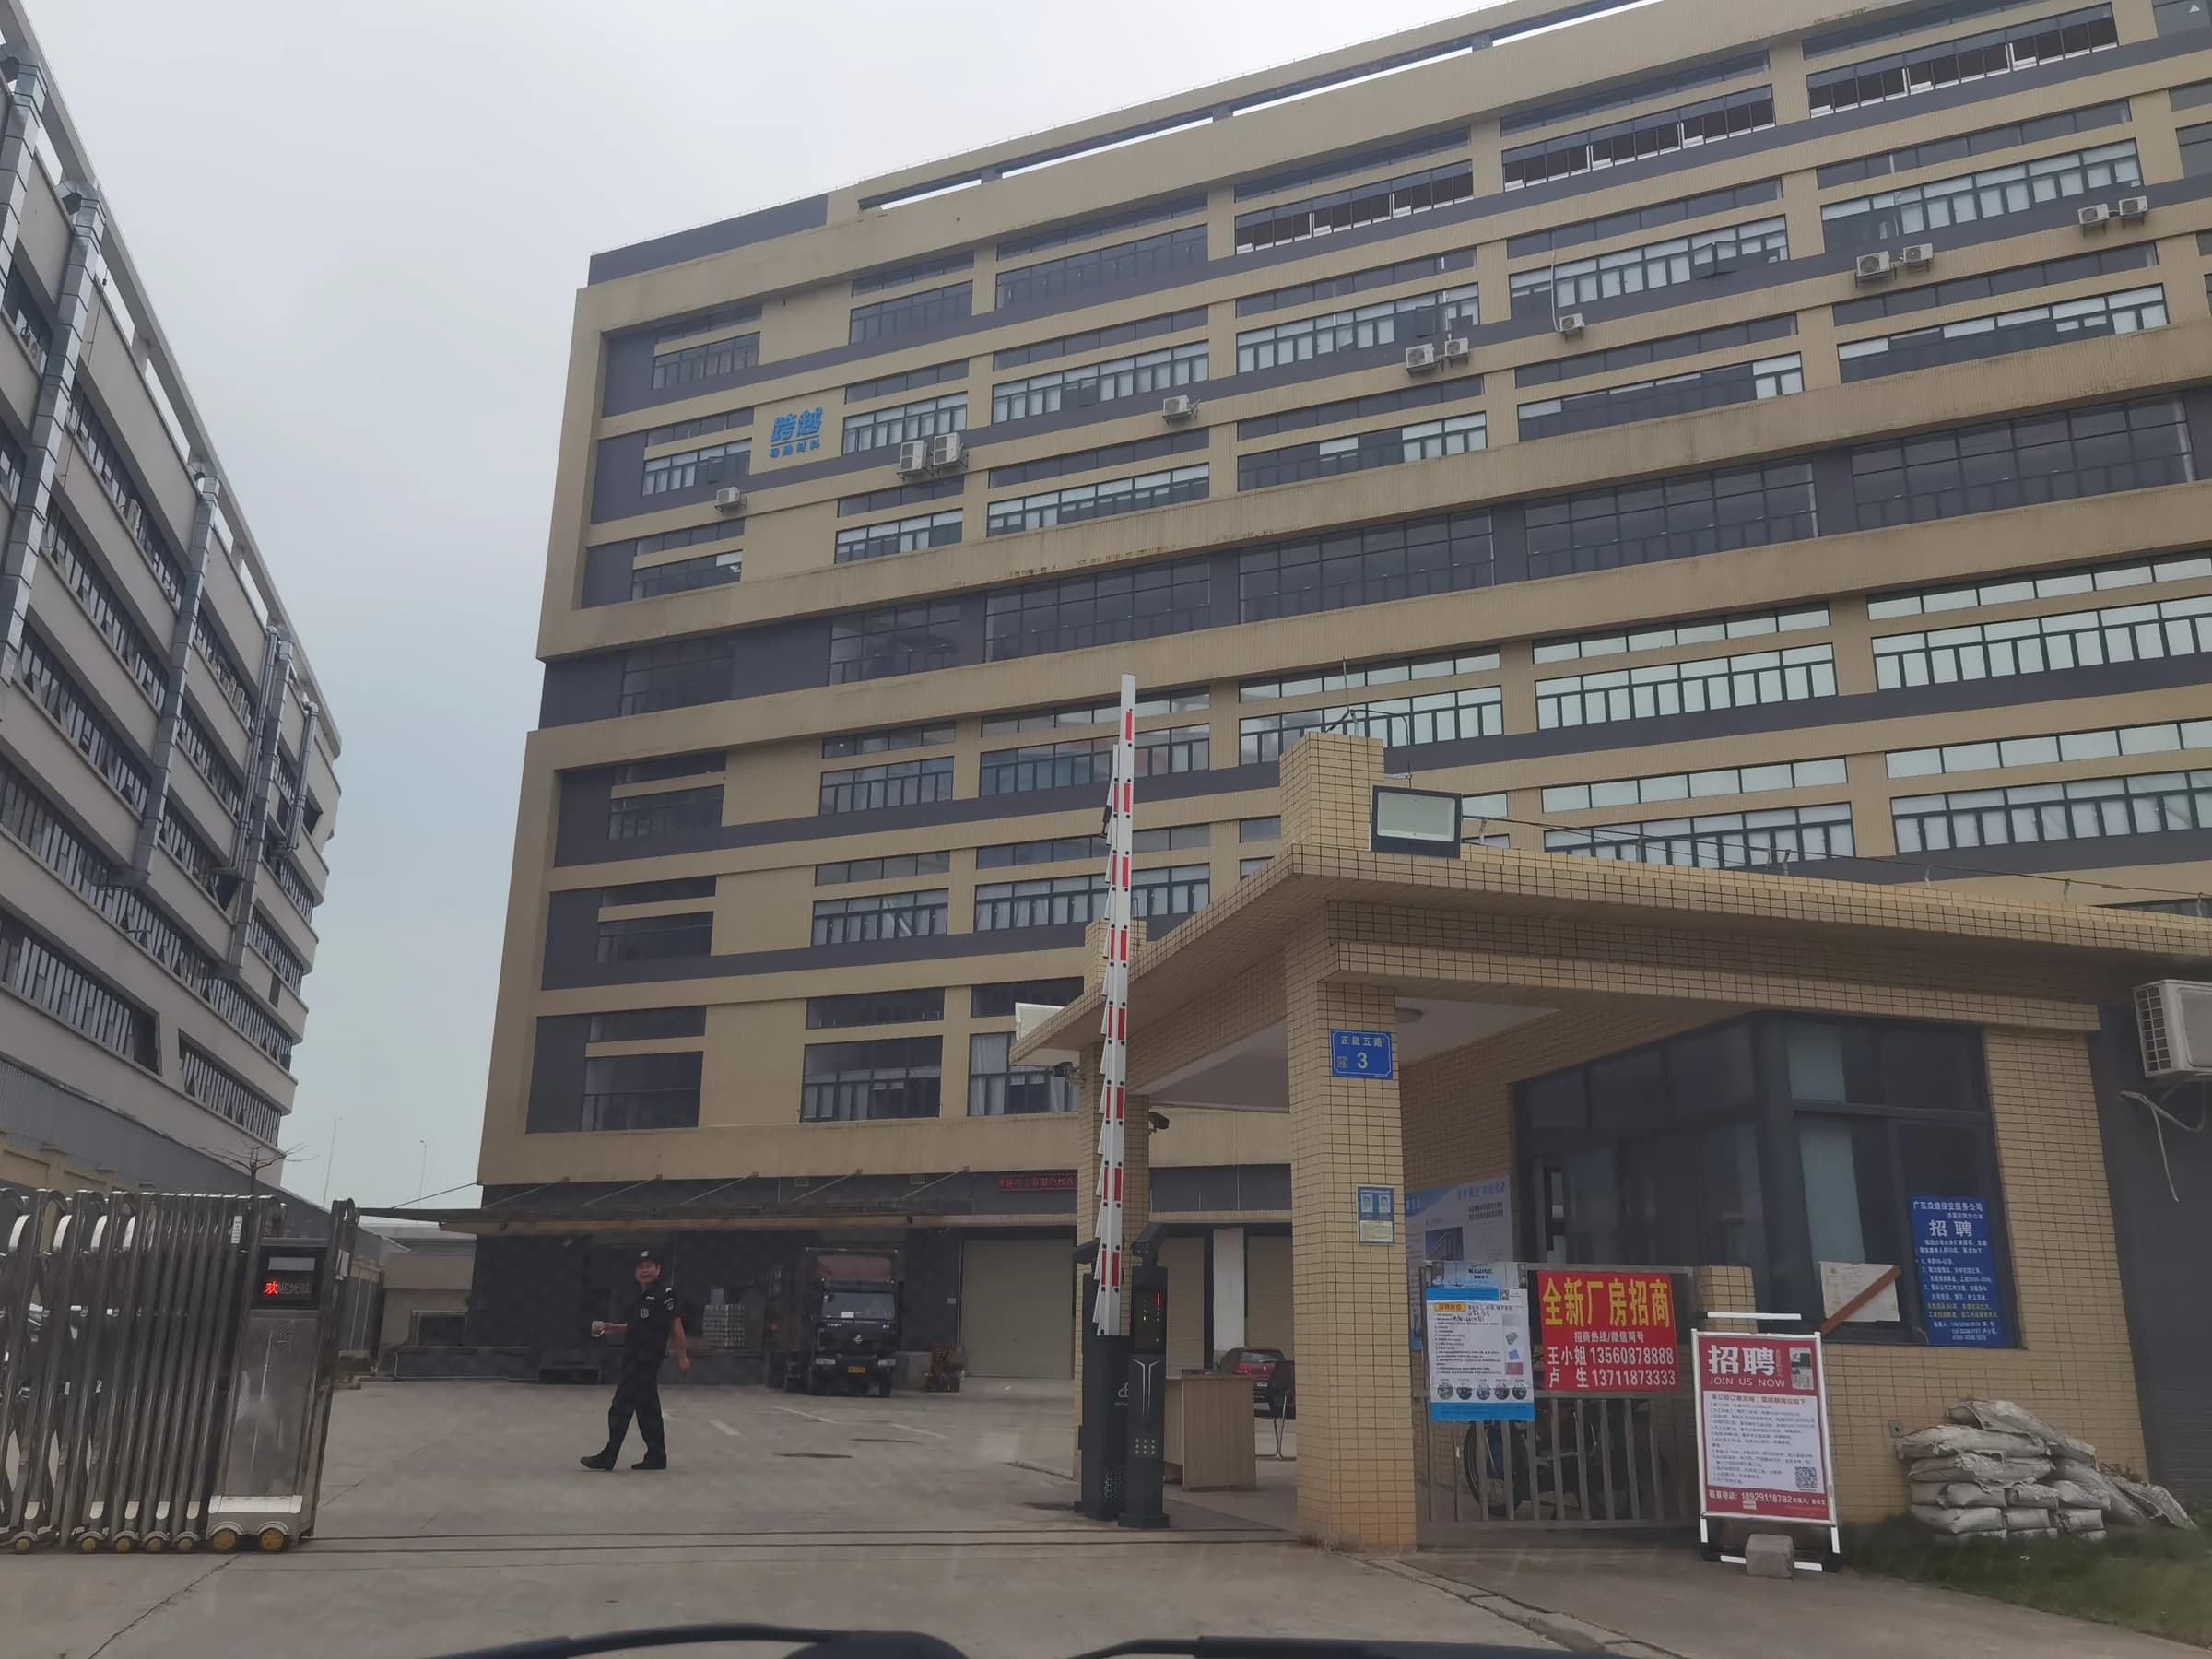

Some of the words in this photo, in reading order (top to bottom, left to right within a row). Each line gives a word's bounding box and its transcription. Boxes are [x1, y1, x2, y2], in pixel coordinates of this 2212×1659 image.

[1357, 1052, 1368, 1069] 3
[1929, 1219, 1972, 1237] 招聘
[1543, 1277, 1670, 1328] 全新厂房招商
[1574, 1331, 1645, 1343] 招商热线/微信同号
[1547, 1346, 1587, 1366] 王小姐
[1590, 1347, 1674, 1365] 13560878888
[1708, 1344, 1775, 1376] 招聘
[1592, 1369, 1676, 1387] 13711873333
[1711, 1377, 1733, 1385] JOIN
[1739, 1378, 1753, 1386] US
[1759, 1378, 1785, 1388] NOW
